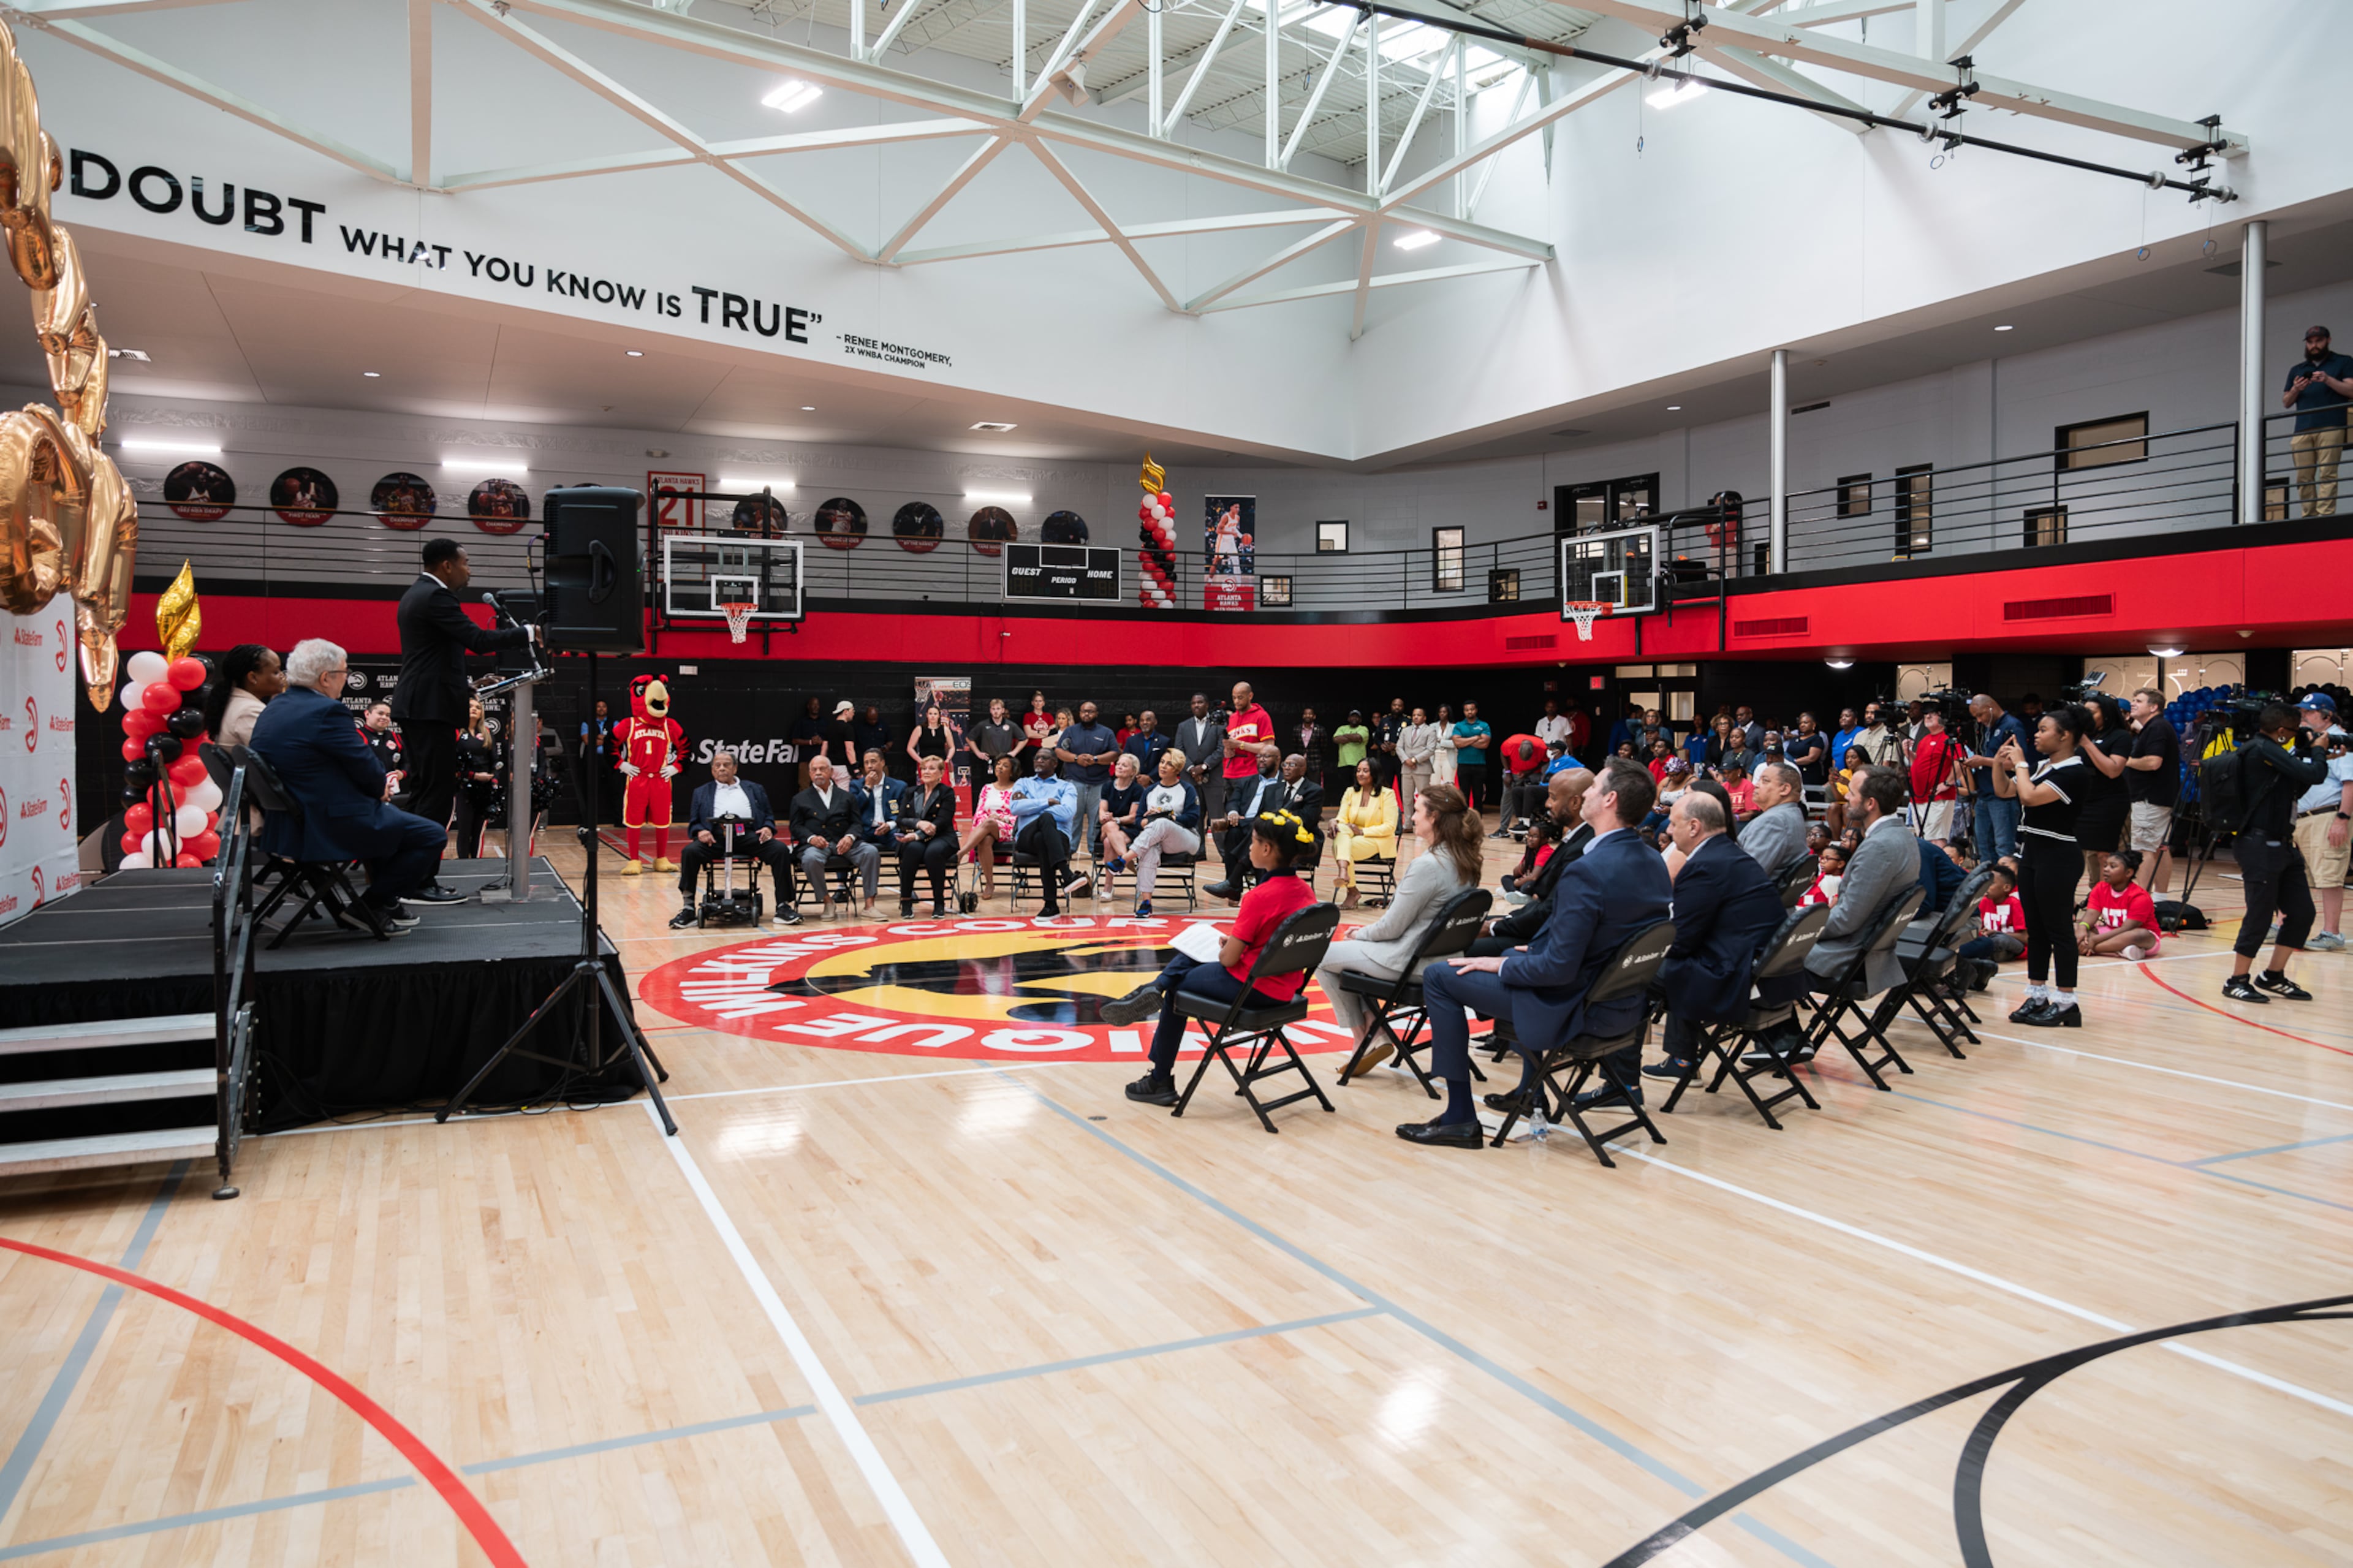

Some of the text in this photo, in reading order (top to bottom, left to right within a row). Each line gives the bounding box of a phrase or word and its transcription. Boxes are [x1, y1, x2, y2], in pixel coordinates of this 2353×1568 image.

[70, 148, 326, 243] DOUBT
[339, 225, 453, 271] WHAT
[464, 251, 534, 287] YOU
[547, 269, 646, 310] KNOW
[657, 292, 681, 318] IS
[844, 335, 878, 350] RENEE
[881, 341, 952, 367] MONTGOMERY,
[857, 348, 882, 359] WNBA
[884, 354, 925, 368] CHAMPION
[658, 486, 694, 526] 21
[1011, 567, 1113, 579] GUEST HOME
[634, 728, 666, 740] ATLANTA
[645, 740, 653, 754] 1
[679, 934, 879, 1020] WILKINS
